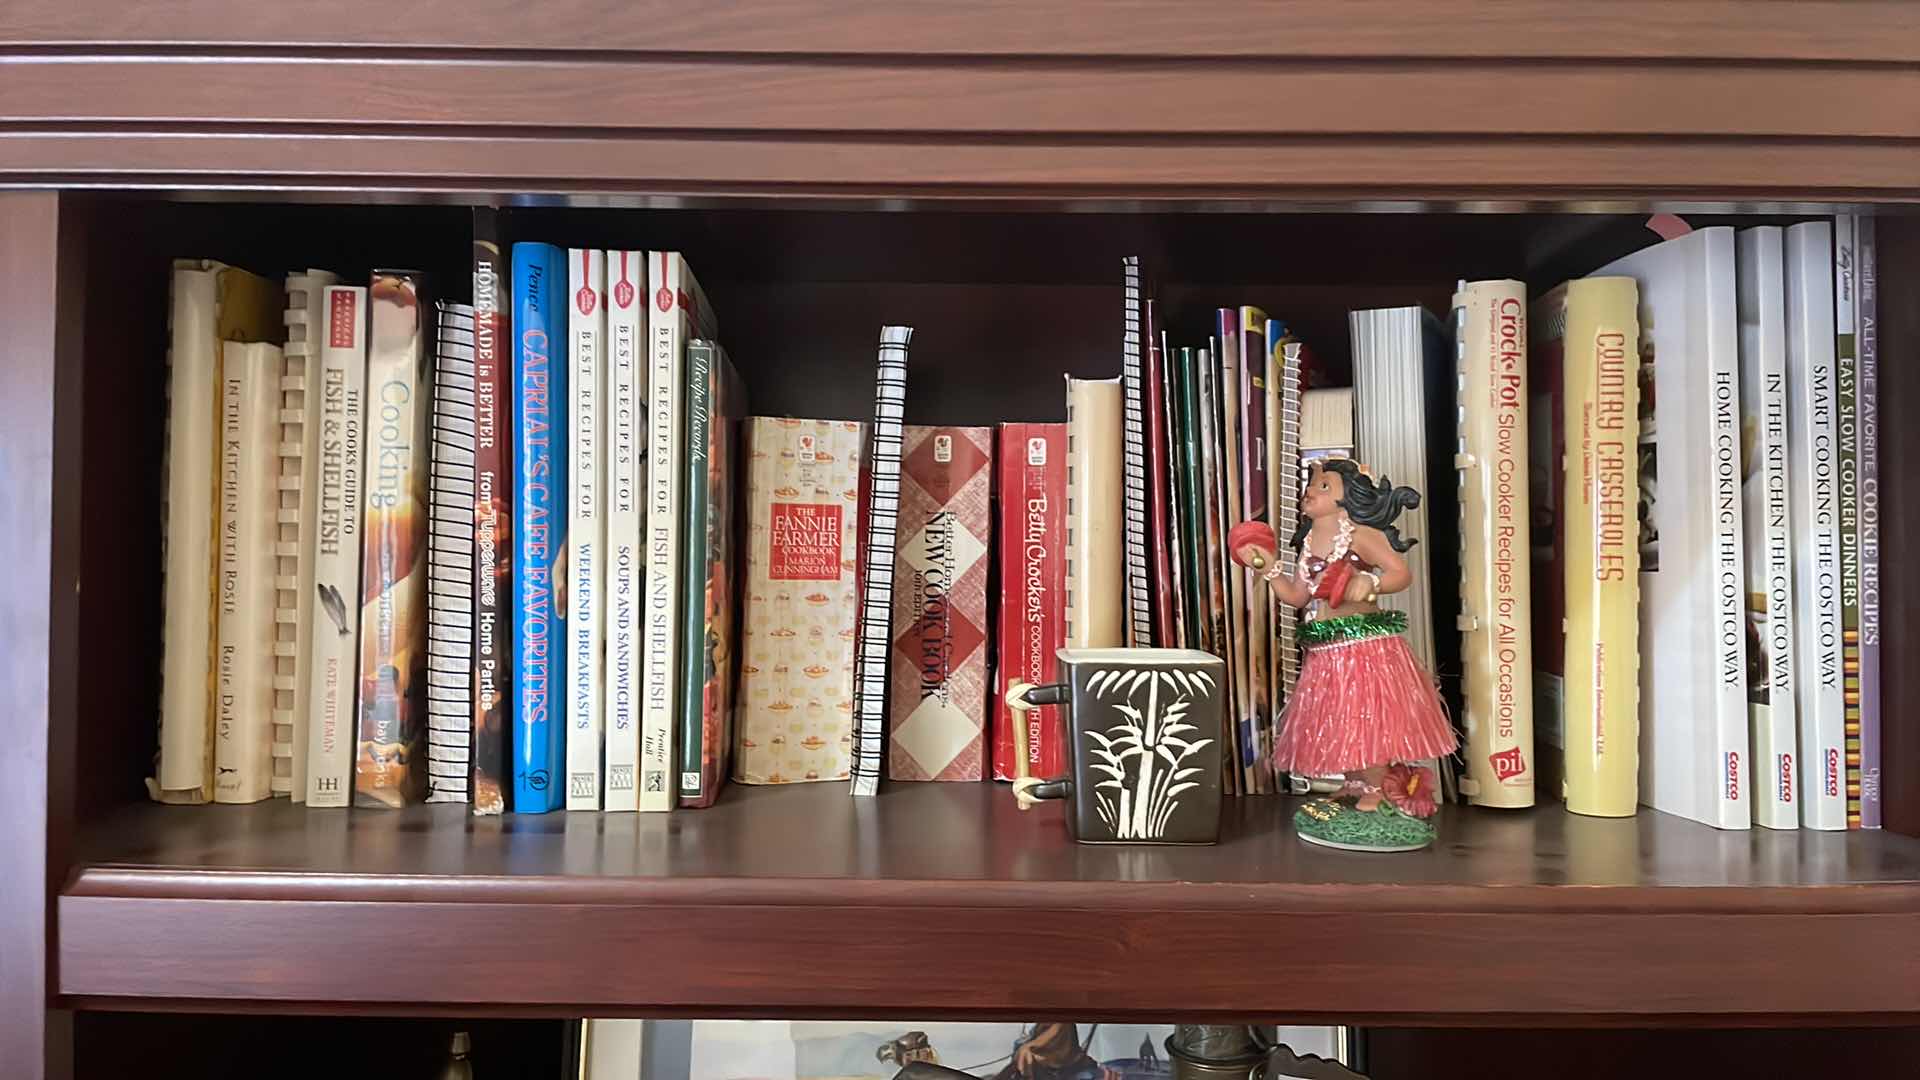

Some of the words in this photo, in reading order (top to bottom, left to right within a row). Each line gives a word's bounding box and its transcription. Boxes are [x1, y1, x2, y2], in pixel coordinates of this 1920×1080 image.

[478, 261, 495, 360] HOMEMADE
[527, 264, 544, 313] Pence
[479, 364, 494, 377] is
[580, 332, 592, 375] BEST
[618, 325, 630, 369] BEST
[658, 327, 669, 372] BEST
[1863, 316, 1877, 389] ALL-TIME
[228, 379, 241, 396] IN
[326, 367, 344, 417] FISH
[347, 390, 358, 415] THE
[690, 357, 708, 407] Recipe
[1595, 332, 1625, 431] COUNTRY
[1717, 372, 1731, 430] HOME
[1767, 373, 1781, 393] IN
[1813, 365, 1829, 430] SMART
[1840, 358, 1854, 397] EASY
[228, 402, 240, 432] THE
[324, 420, 340, 436] &
[479, 382, 495, 449] BETTER
[523, 329, 550, 480] CAPRIAL'S
[618, 384, 630, 465] RECIPES
[657, 386, 669, 466] RECIPES
[1768, 399, 1782, 438] THE
[370, 381, 410, 509] Cooking
[580, 390, 592, 470] RECIPES
[691, 408, 708, 462] Records
[1498, 414, 1516, 456] Slow
[1840, 404, 1856, 456] SLOW
[1863, 394, 1878, 472] FAVORITE
[226, 440, 241, 513] KITCHEN
[321, 440, 341, 555] SHELLFISH
[345, 471, 357, 512] GUIDE
[479, 471, 496, 505] from
[580, 484, 592, 519] FOR
[618, 478, 630, 513] FOR
[656, 480, 668, 514] FOR
[1498, 459, 1516, 522] Cooker
[1718, 434, 1734, 524] COOKING
[1769, 444, 1784, 527] KITCHEN
[1815, 434, 1832, 525] COOKING
[1841, 458, 1856, 527] COOKER
[344, 515, 356, 535] TO
[522, 483, 549, 561] CAFE
[775, 515, 837, 532] FANNIE
[795, 507, 816, 517] THE
[943, 511, 957, 557] Better
[1025, 496, 1048, 543] Betty
[1595, 441, 1625, 582] CASSEROLES
[1863, 479, 1878, 558] COOKIE
[476, 505, 498, 607] Tupperware
[654, 528, 669, 565] FISH
[772, 530, 840, 547] FARMER
[782, 546, 836, 555] COOKBOOK
[925, 511, 945, 566] NEW
[1495, 526, 1515, 594] Recipes
[1721, 528, 1736, 568] THE
[1771, 532, 1785, 571] THE
[1818, 528, 1833, 569] THE
[577, 543, 592, 622] WEEKEND
[617, 546, 631, 595] SOUPS
[652, 569, 668, 609] AND
[1025, 543, 1046, 623] Crocker's
[1842, 535, 1857, 607] DINNERS
[617, 597, 631, 630] AND
[922, 568, 945, 633] COOK
[1498, 597, 1515, 619] for
[1721, 572, 1737, 647] COSTCO
[1772, 576, 1788, 651] COSTCO
[1819, 573, 1835, 648] COSTCO
[1863, 563, 1879, 645] RECIPES
[480, 612, 496, 656] Home
[522, 565, 549, 725] FAVORITES
[1029, 625, 1042, 686] COOKBOOK
[1499, 623, 1516, 646] All
[222, 645, 235, 685] Rosie
[326, 658, 337, 685] KATE
[480, 660, 497, 712] Parties
[577, 629, 591, 730] BREAKFASTS
[616, 632, 630, 730] SANDWICHES
[650, 613, 668, 710] SHELLFISH
[920, 638, 943, 702] BOOK
[219, 695, 234, 741] Daley
[1499, 648, 1516, 738] Occasions
[324, 687, 337, 753] WHITEMAN
[1029, 722, 1041, 763] EDITION
[645, 736, 654, 756] Hall
[656, 728, 667, 763] Prentice
[1495, 752, 1525, 775] pil
[1730, 752, 1739, 801] COSTCO
[1782, 753, 1792, 803] COSTCO
[1828, 748, 1839, 797] COSTCO
